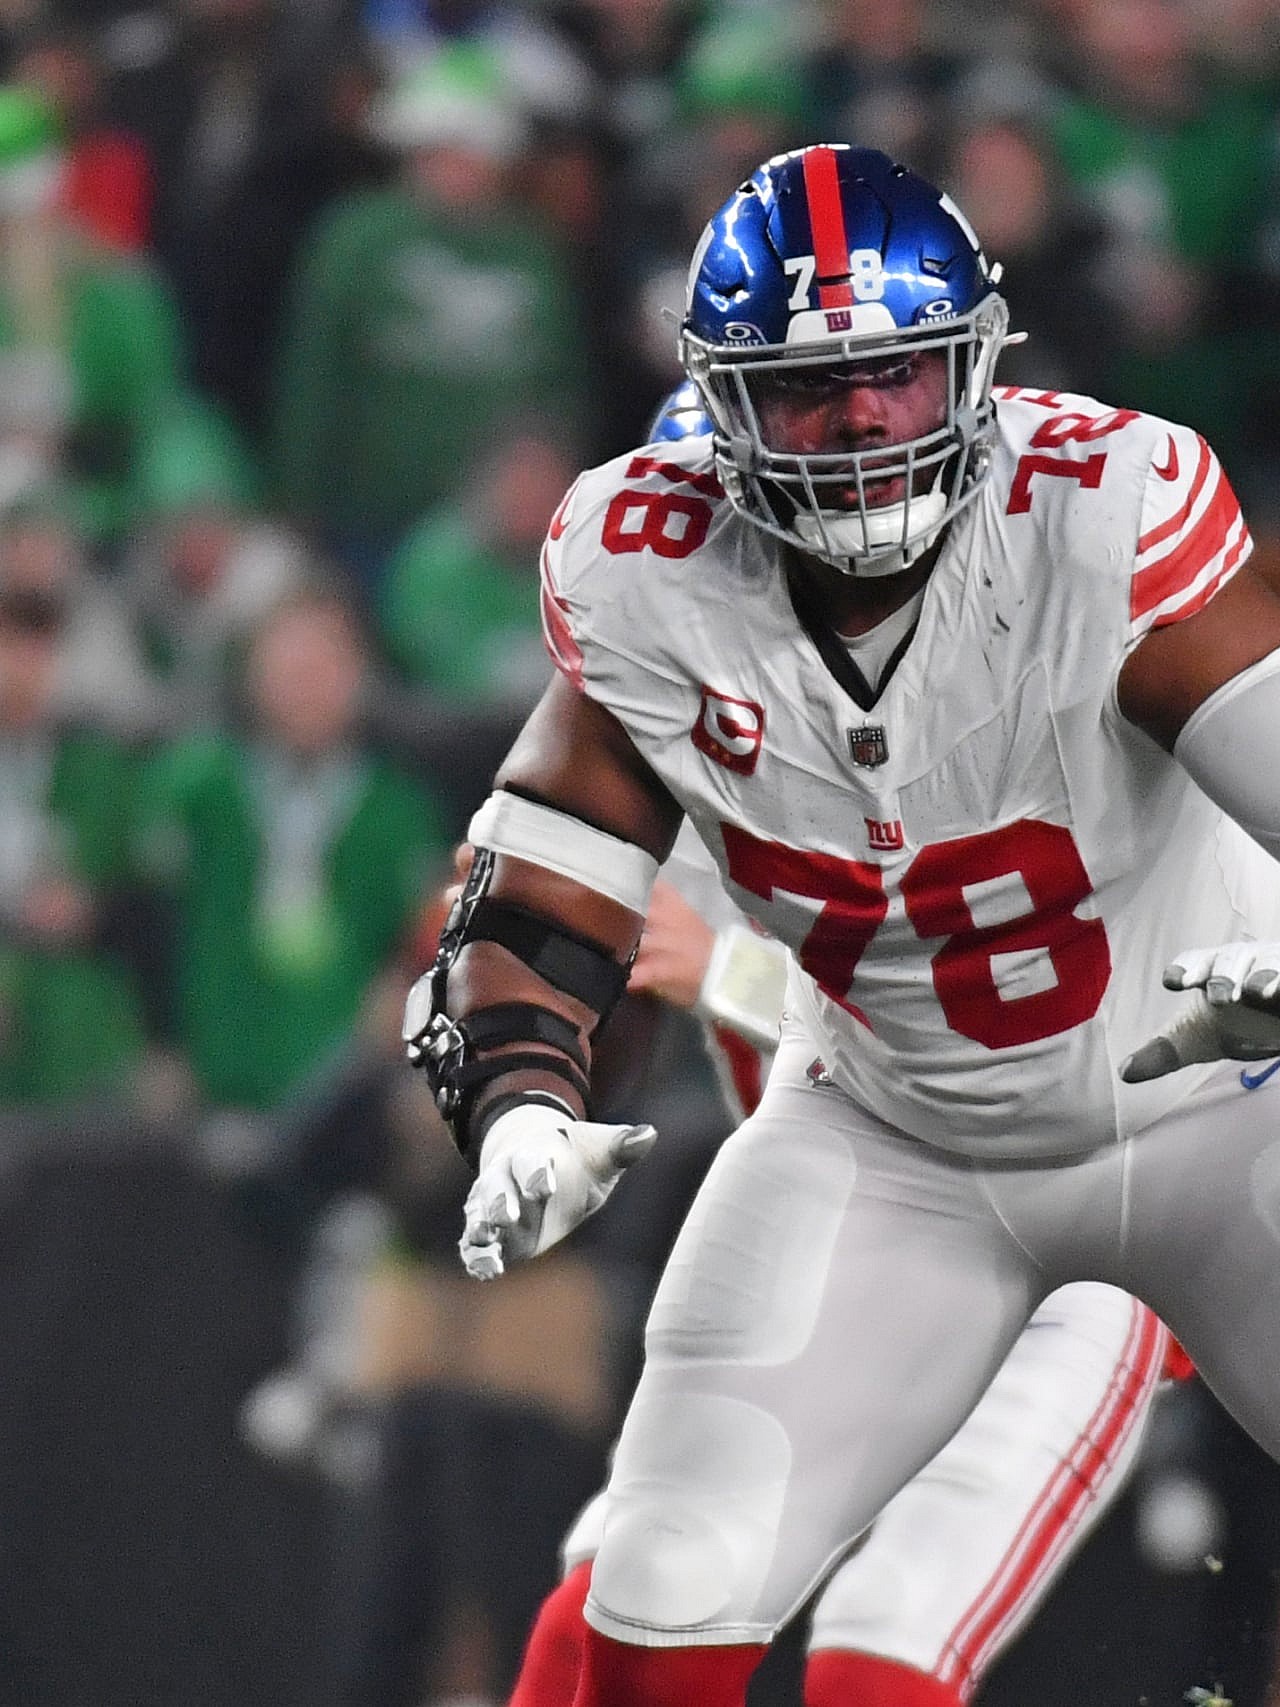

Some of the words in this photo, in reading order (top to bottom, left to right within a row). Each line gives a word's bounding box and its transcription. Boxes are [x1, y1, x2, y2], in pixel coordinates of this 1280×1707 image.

[601, 456, 727, 559] 78
[1006, 408, 1142, 516] 78
[704, 694, 759, 756] C
[720, 817, 1113, 1051] 78
